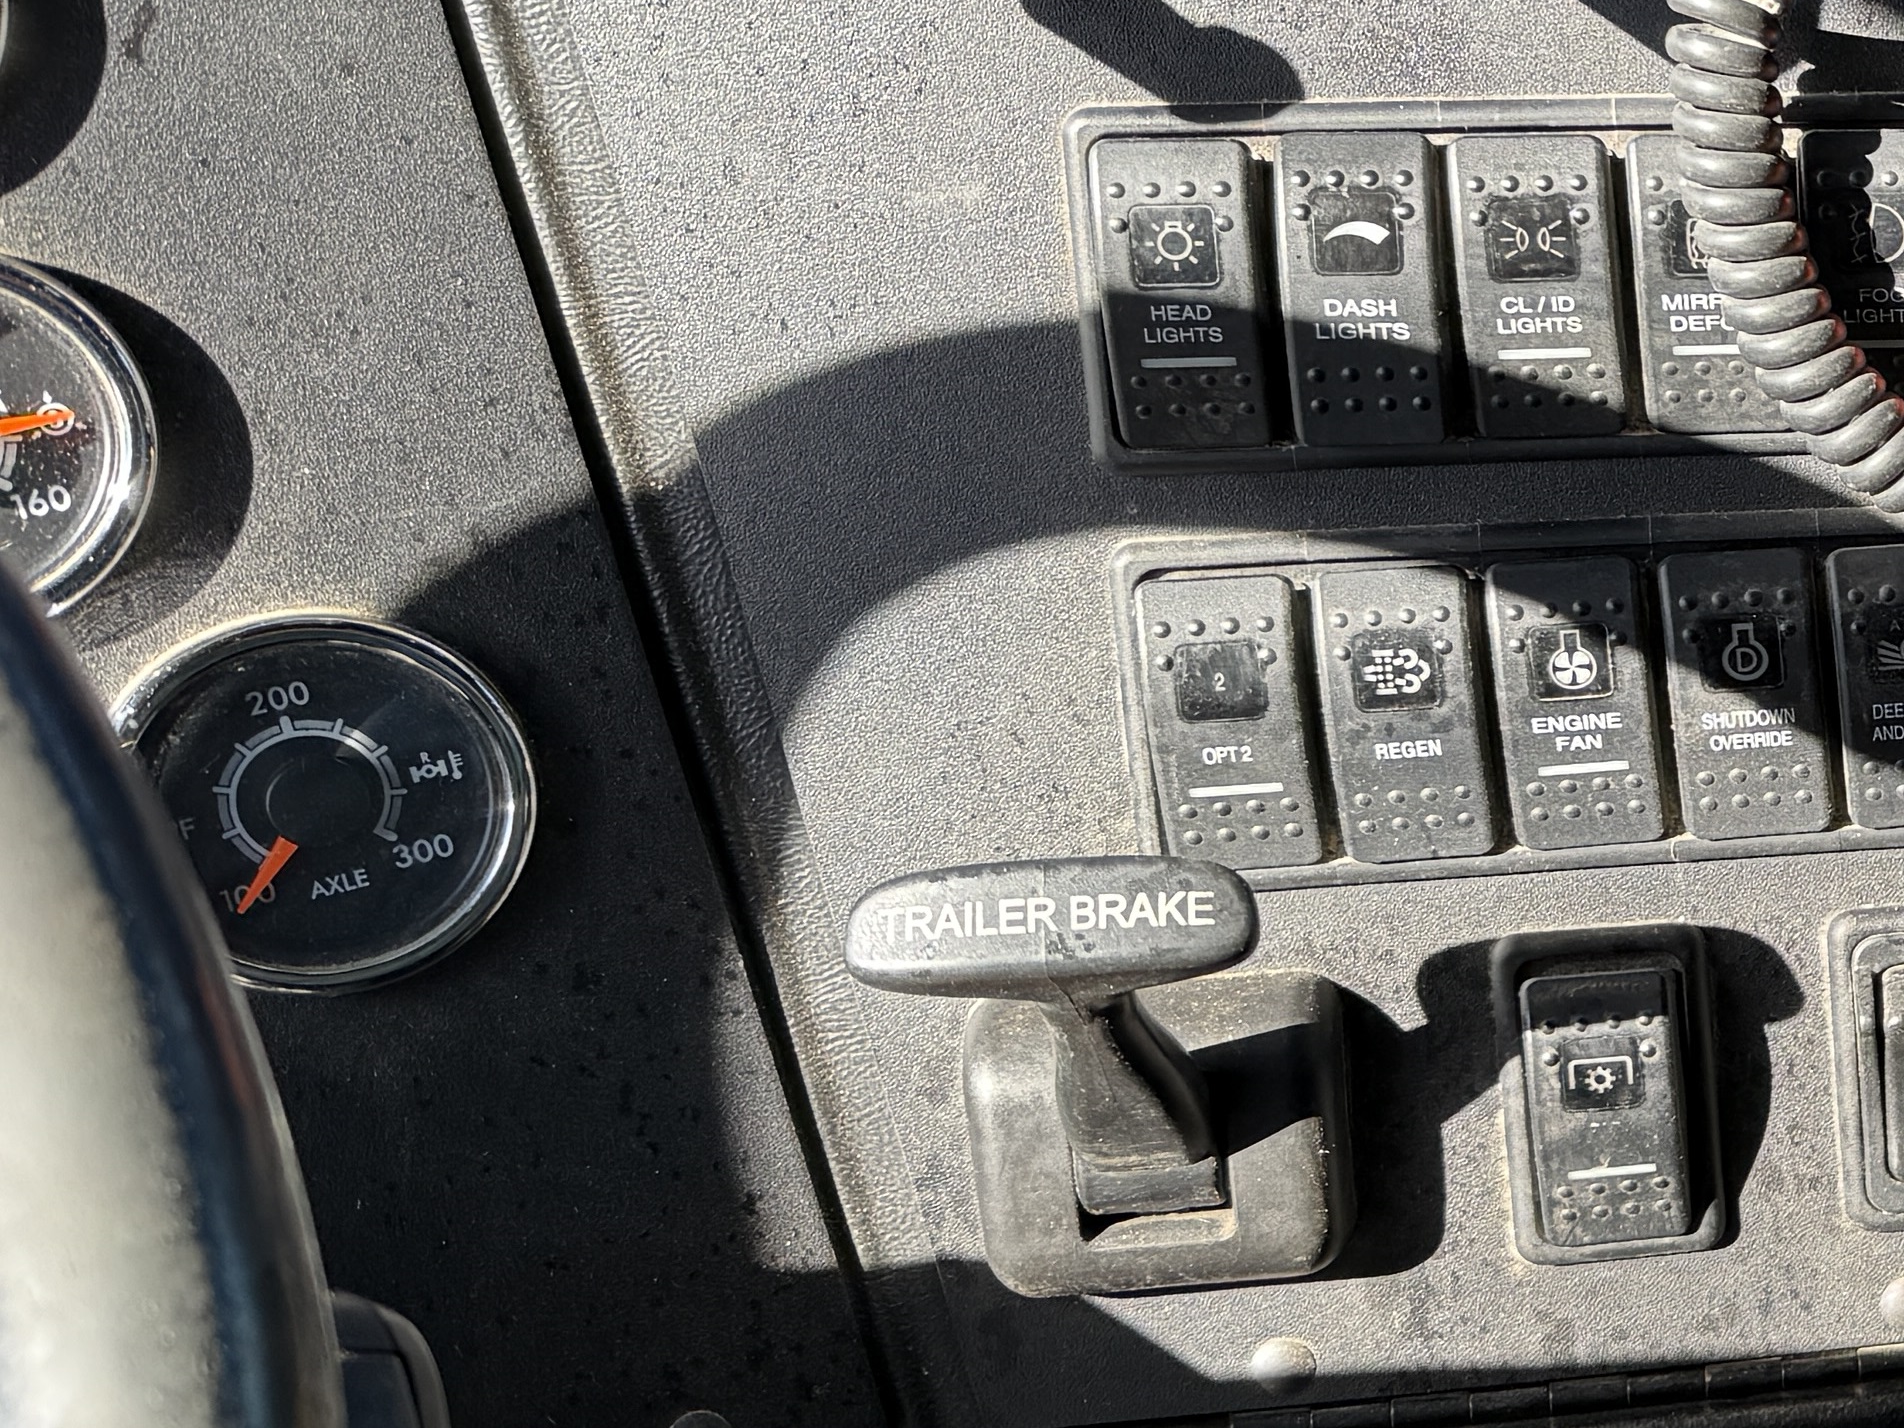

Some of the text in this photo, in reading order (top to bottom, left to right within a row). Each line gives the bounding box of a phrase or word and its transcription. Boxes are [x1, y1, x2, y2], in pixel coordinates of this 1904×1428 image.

[1323, 298, 1398, 319] DASH
[1661, 293, 1722, 311] MIRR
[1150, 305, 1213, 323] HEAD
[1143, 326, 1224, 344] LIGHTS
[1314, 320, 1411, 342] LIGHTS
[1496, 316, 1583, 335] LIGHTS
[11, 484, 71, 519] 160
[1214, 673, 1226, 692] 2
[245, 681, 311, 716] 200
[1531, 712, 1623, 734] ENGINE
[1701, 707, 1795, 731] SHUTDOWN
[1375, 740, 1443, 760] REGEN
[1556, 733, 1603, 753] FAN
[1710, 730, 1793, 752] OVERRIDE
[393, 834, 454, 869] 300
[311, 869, 370, 900] AXLE
[878, 891, 1216, 944] TRAILER BRAKE
